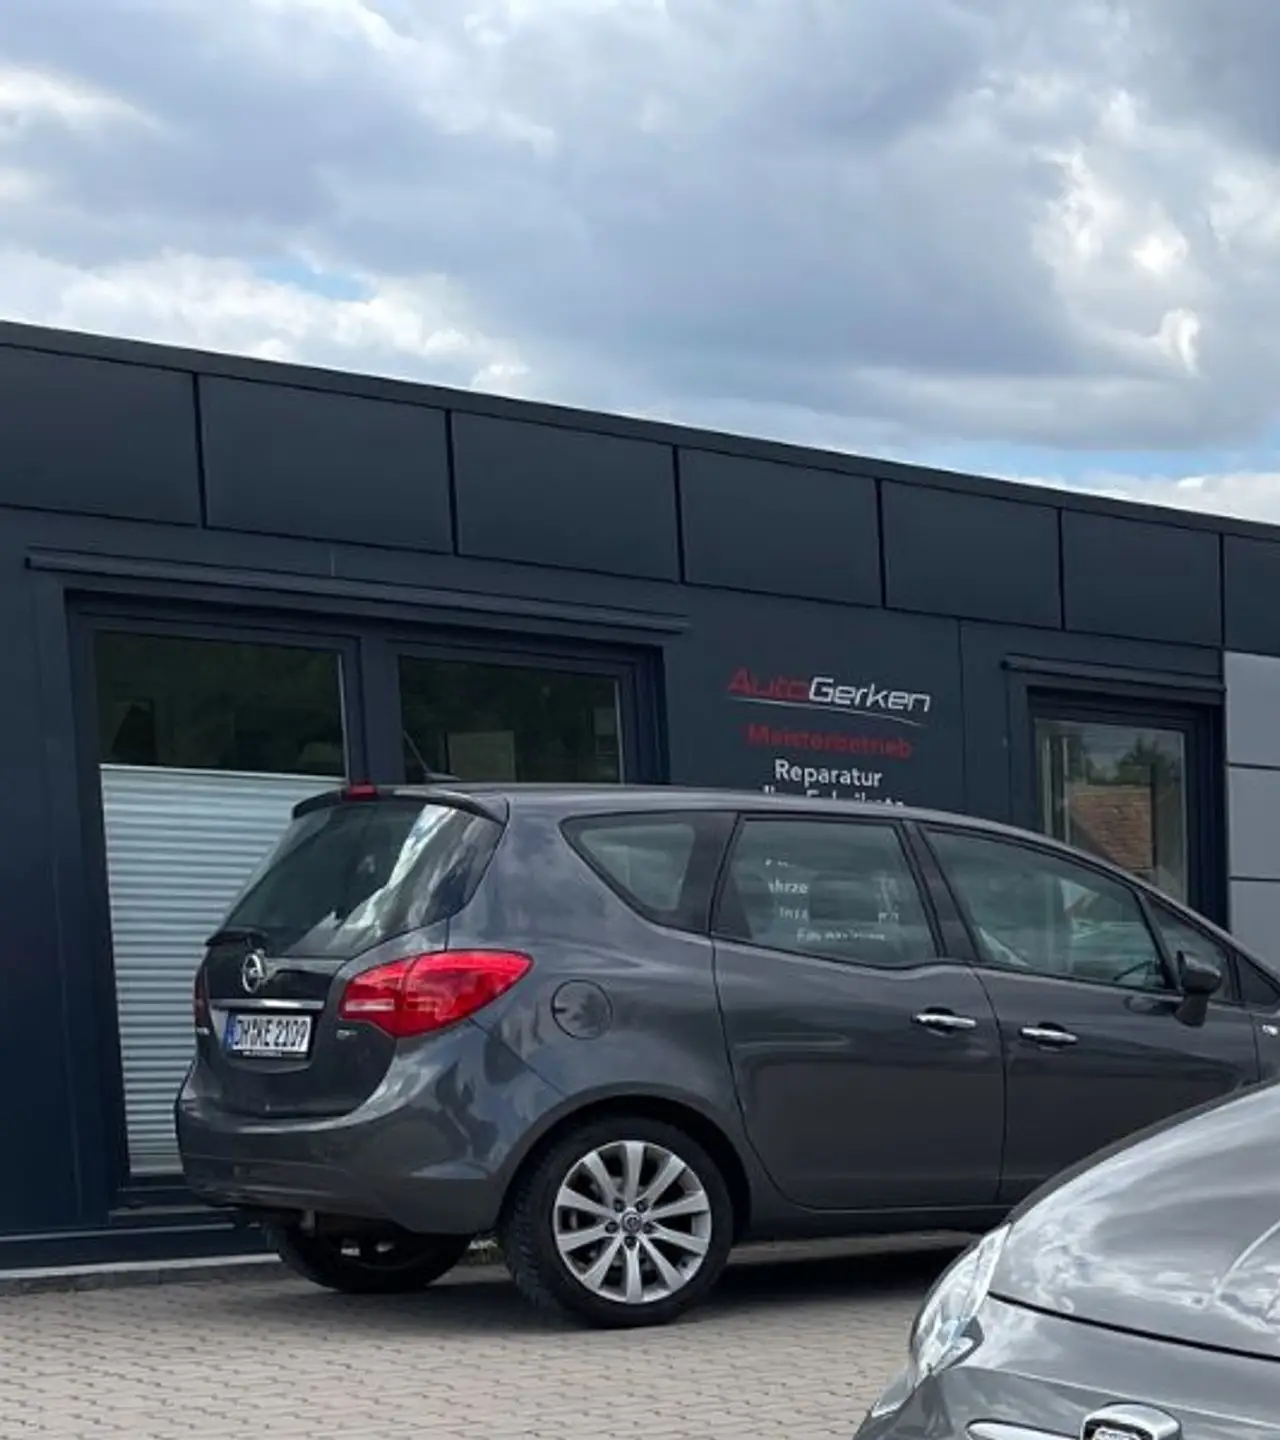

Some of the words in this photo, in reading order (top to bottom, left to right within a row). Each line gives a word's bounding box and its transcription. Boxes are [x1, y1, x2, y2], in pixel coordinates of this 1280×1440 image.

[728, 667, 931, 712] AutoGerken
[747, 723, 913, 758] Meisterbetrieb
[774, 758, 883, 788] Reparatur
